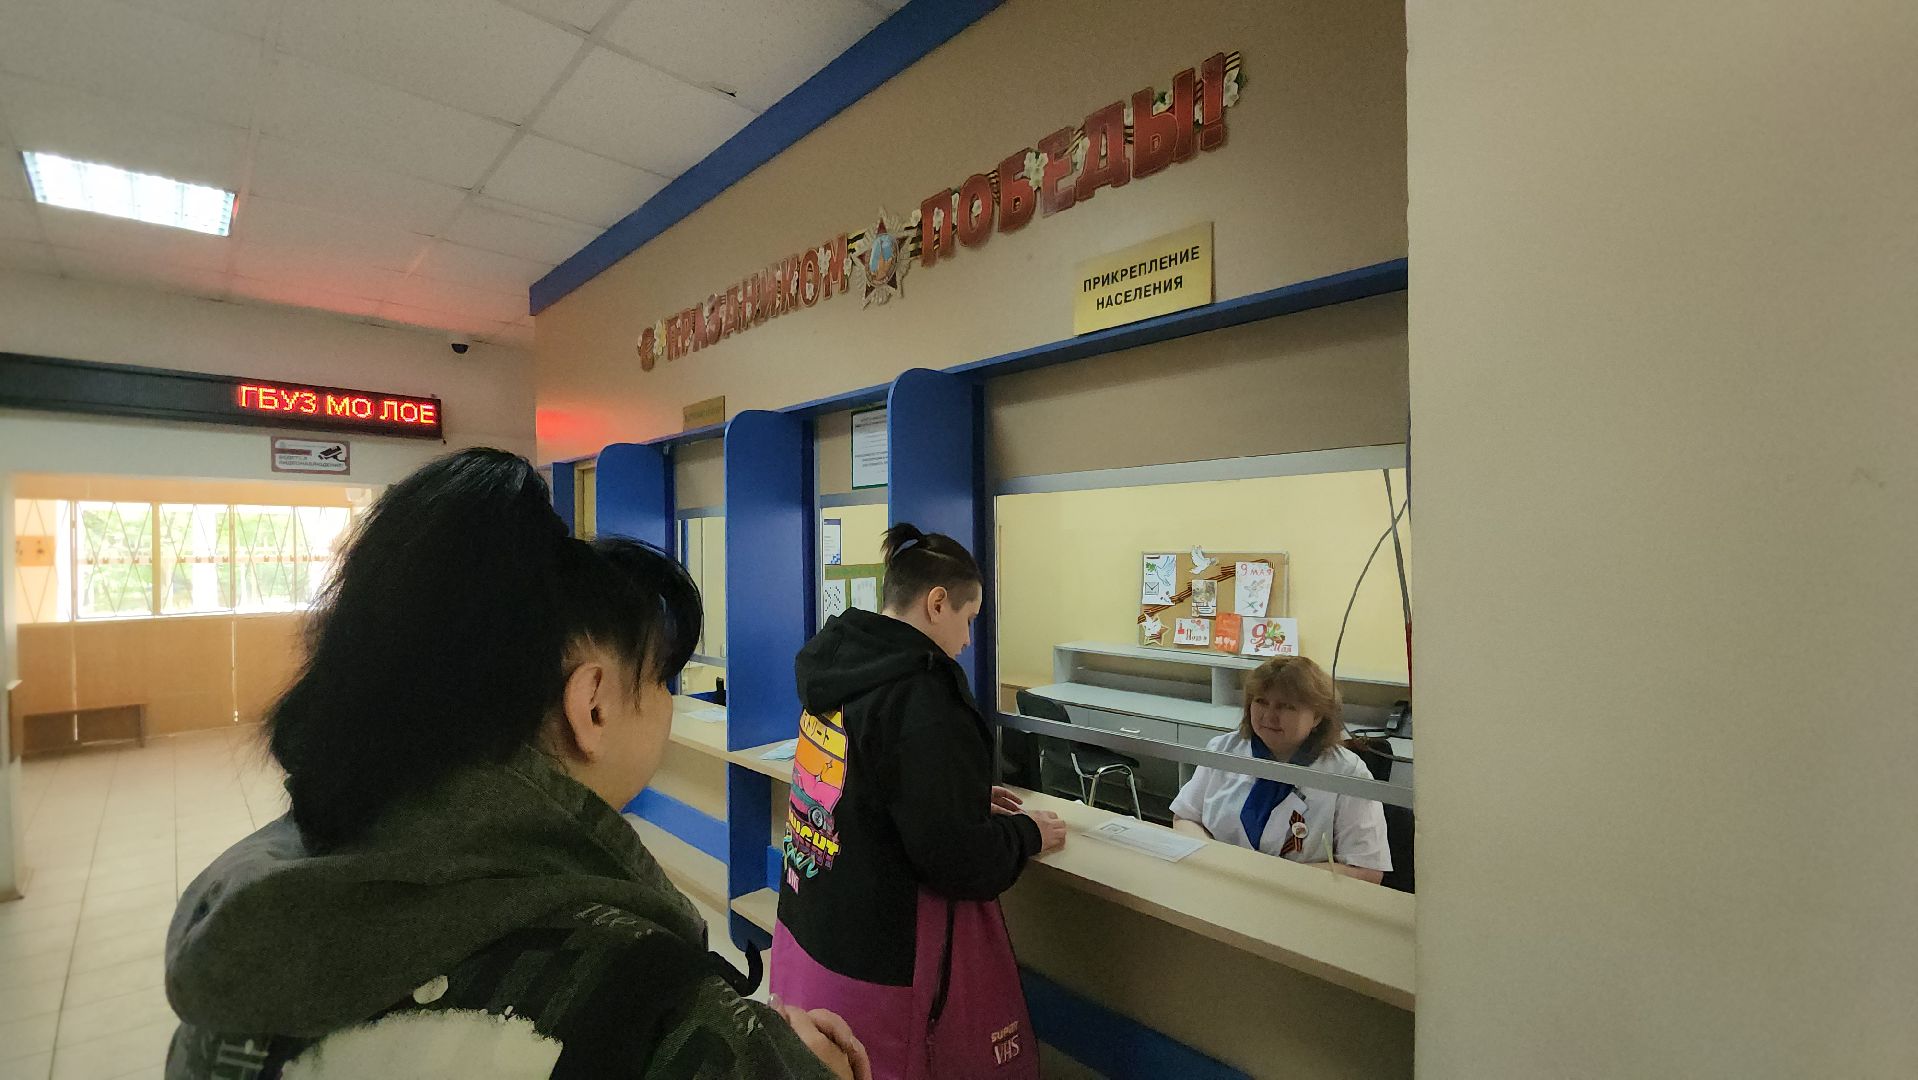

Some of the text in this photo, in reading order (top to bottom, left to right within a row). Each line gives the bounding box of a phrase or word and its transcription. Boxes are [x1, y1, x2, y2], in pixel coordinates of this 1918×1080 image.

[666, 233, 849, 361] ПРАЗДНИКОМ
[920, 52, 1228, 269] ПОБЕДЫ!
[1083, 245, 1201, 293] ПРИКРЕПЛЕНИЕ
[1096, 275, 1184, 311] НАСЕЛЕНИЯ
[240, 385, 317, 414] ГБУЗ
[326, 394, 372, 418] МО
[994, 1034, 1020, 1065] VHS
